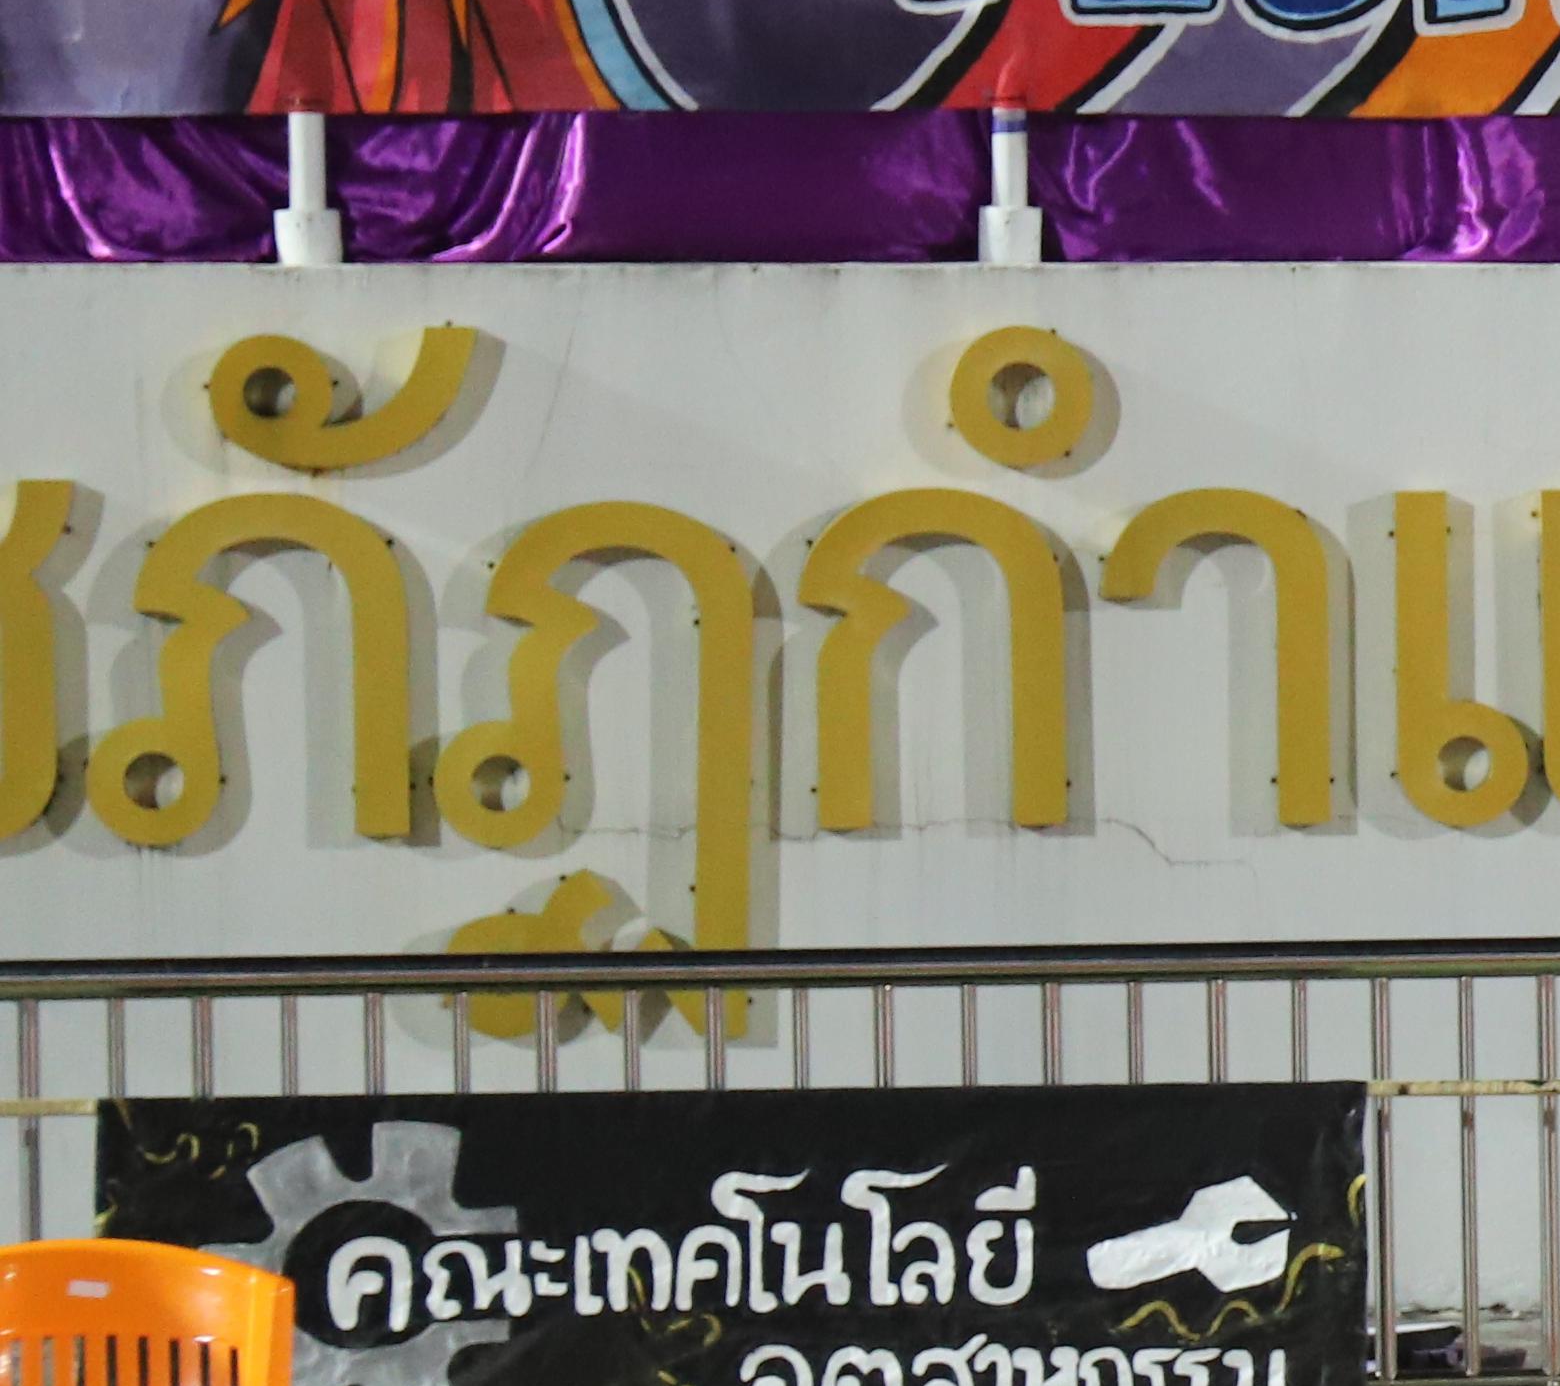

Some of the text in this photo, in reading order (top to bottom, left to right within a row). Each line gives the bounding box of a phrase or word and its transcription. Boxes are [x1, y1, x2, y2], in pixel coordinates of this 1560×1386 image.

[328, 1164, 1037, 1333] คณะเทคโนโลยี
